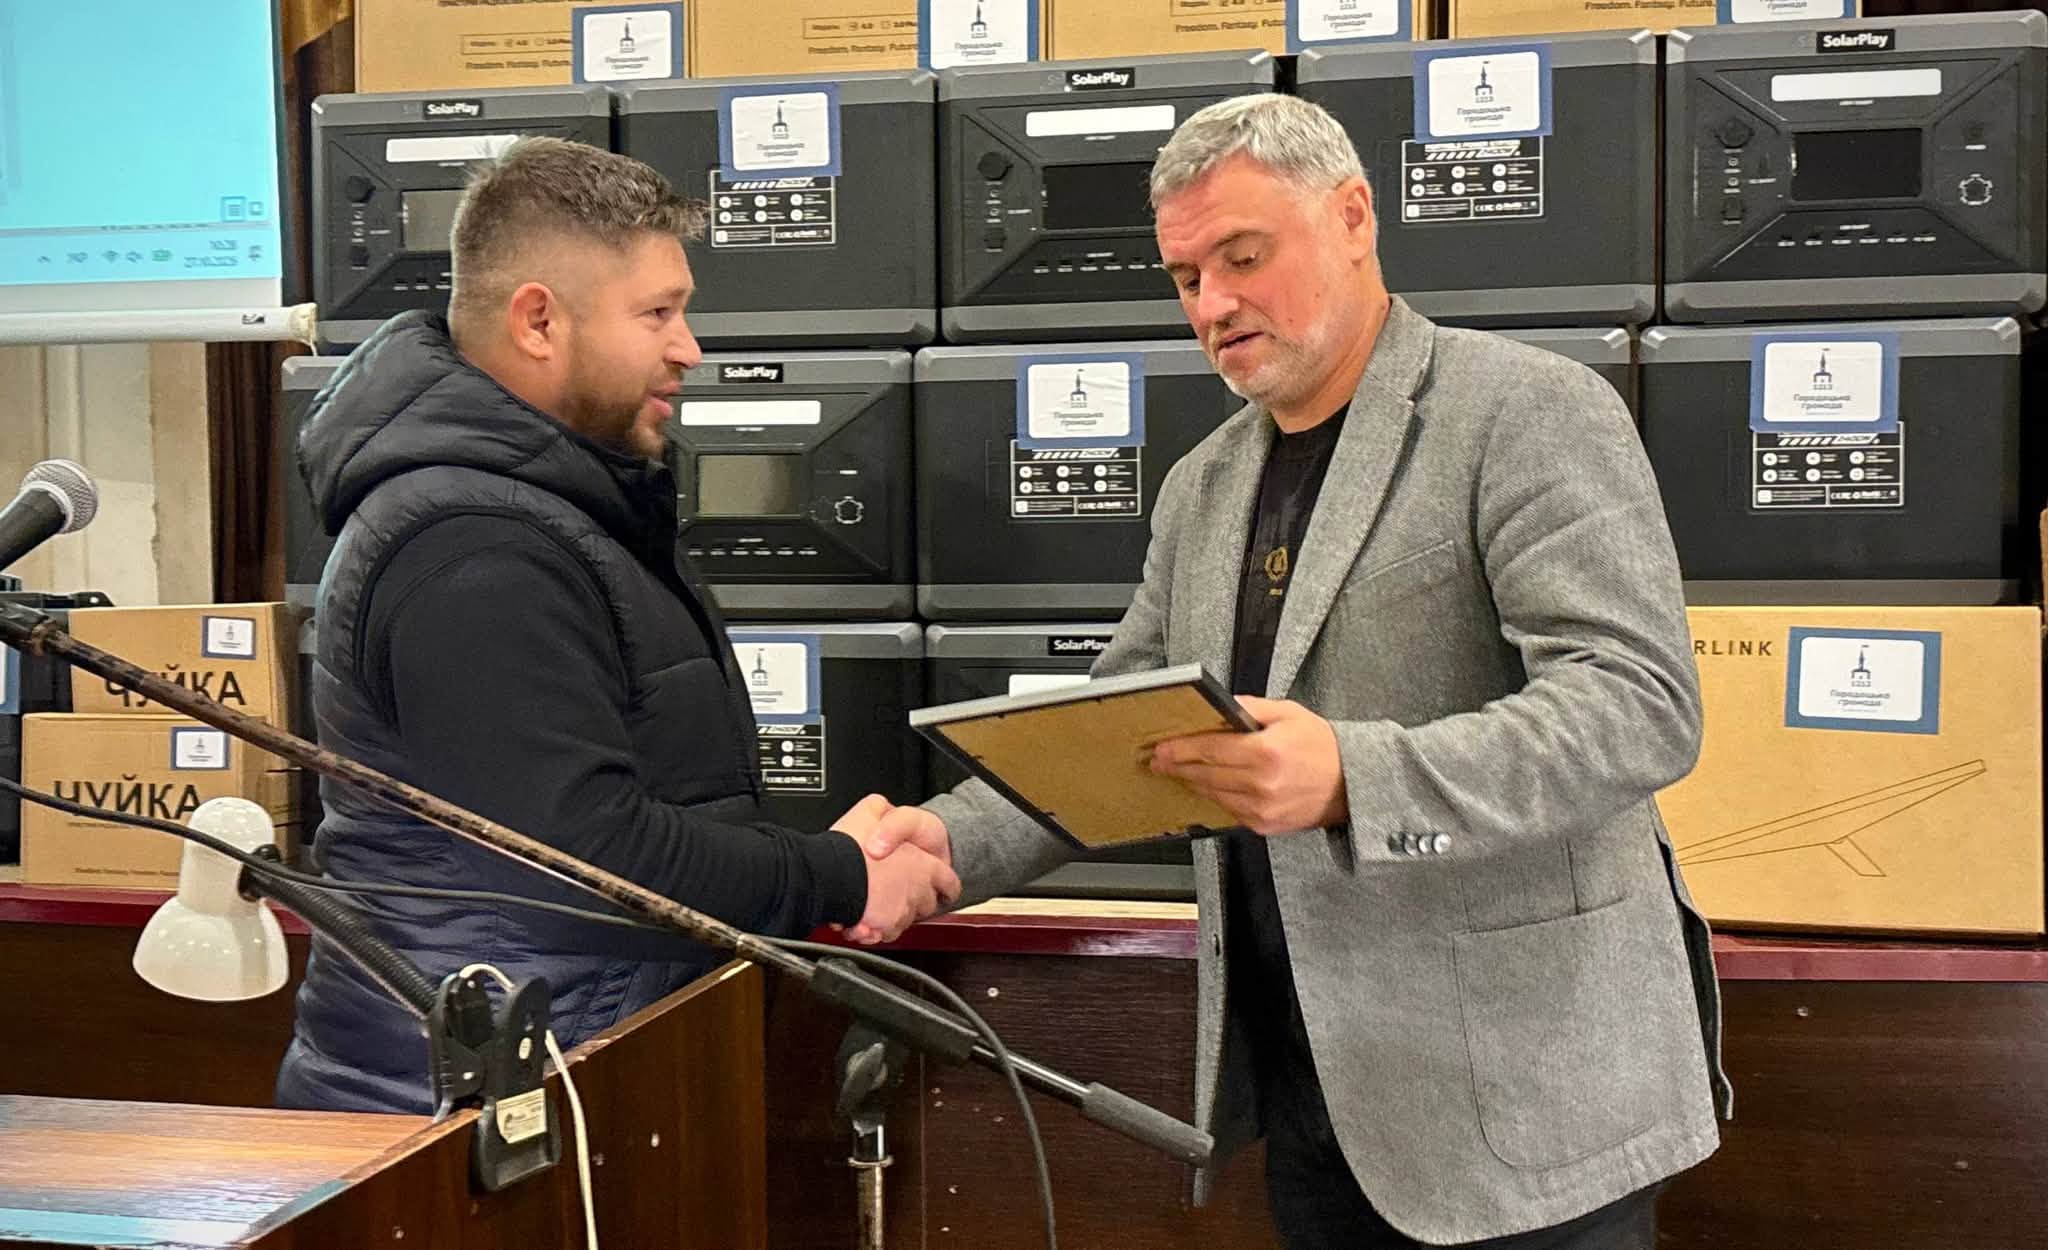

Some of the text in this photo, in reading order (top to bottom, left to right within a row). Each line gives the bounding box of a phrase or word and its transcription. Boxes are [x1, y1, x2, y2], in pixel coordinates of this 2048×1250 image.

[1823, 33, 1888, 48] SolarPlay
[1071, 71, 1129, 86] SolarPlay
[427, 103, 480, 116] SolarPlay
[724, 366, 778, 380] SolarPlay
